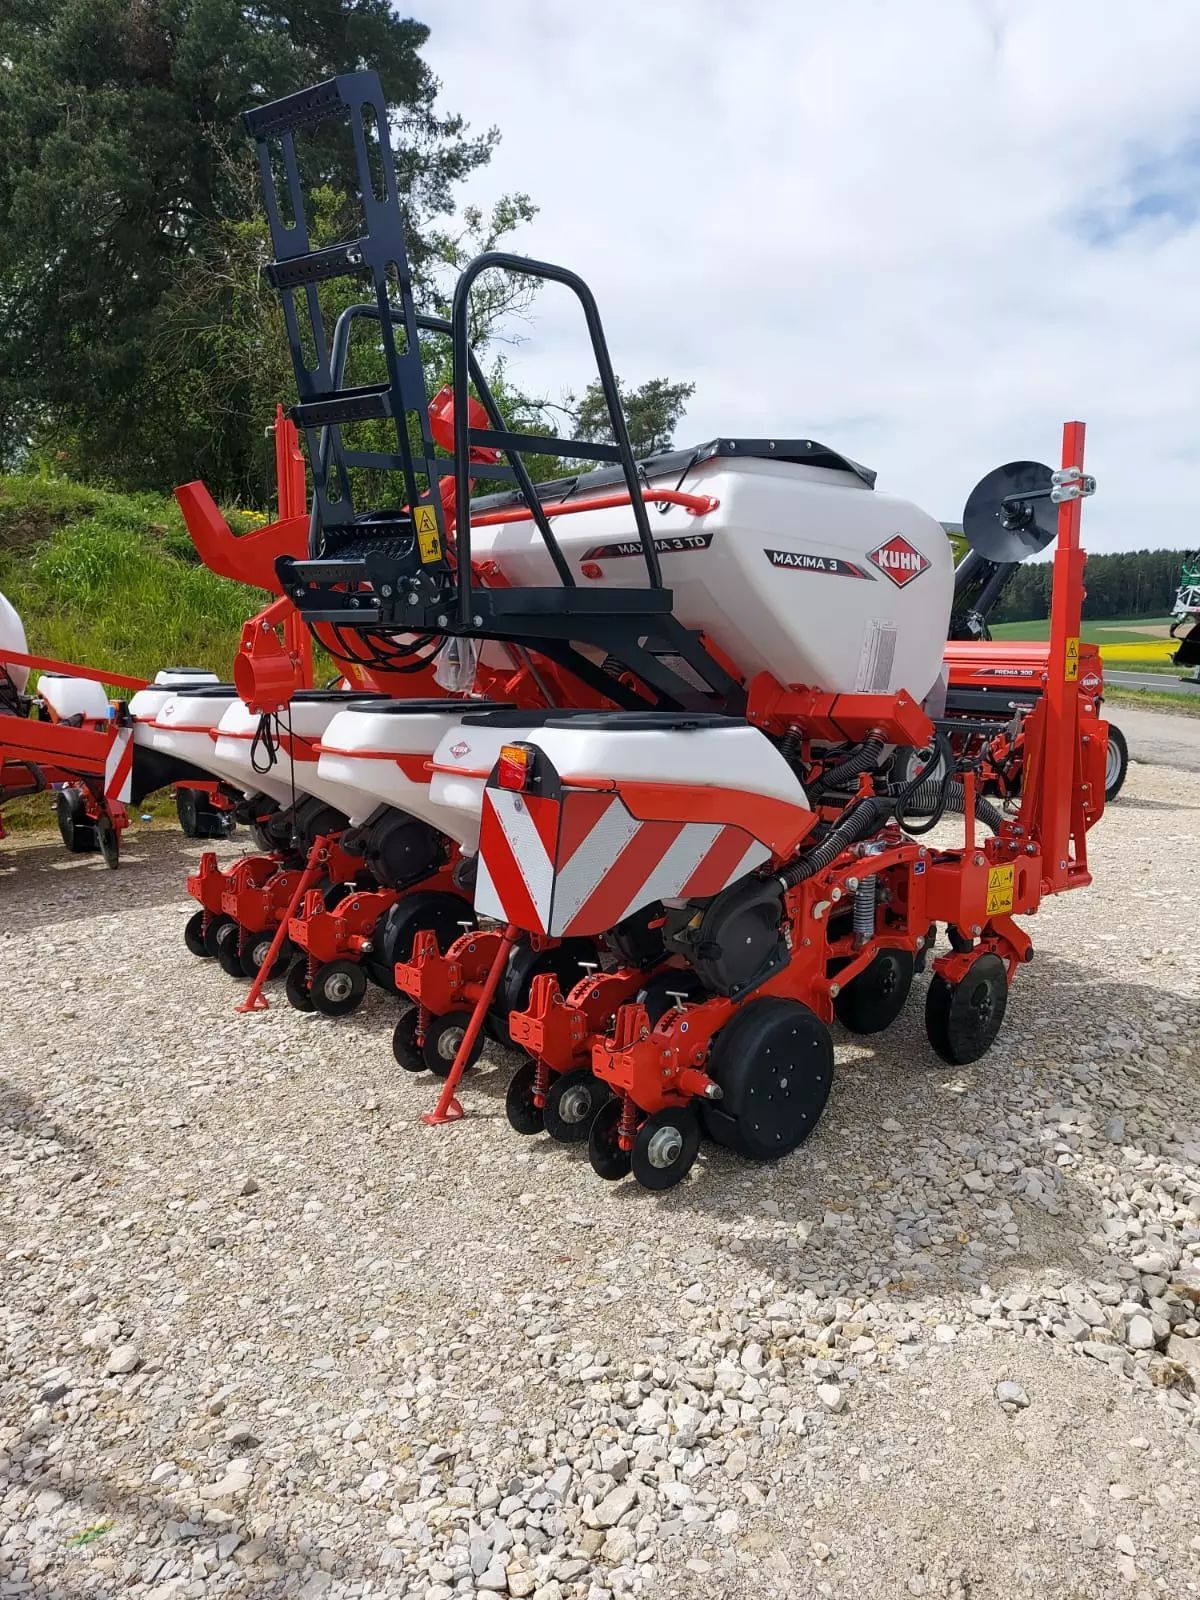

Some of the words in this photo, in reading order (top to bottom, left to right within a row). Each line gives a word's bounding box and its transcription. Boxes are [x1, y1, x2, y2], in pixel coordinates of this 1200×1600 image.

[672, 539, 683, 549] 3
[684, 536, 706, 548] TD
[773, 552, 826, 570] MAXIMA
[829, 560, 838, 571] 3
[878, 549, 921, 571] KUHN
[608, 1056, 615, 1071] 4
